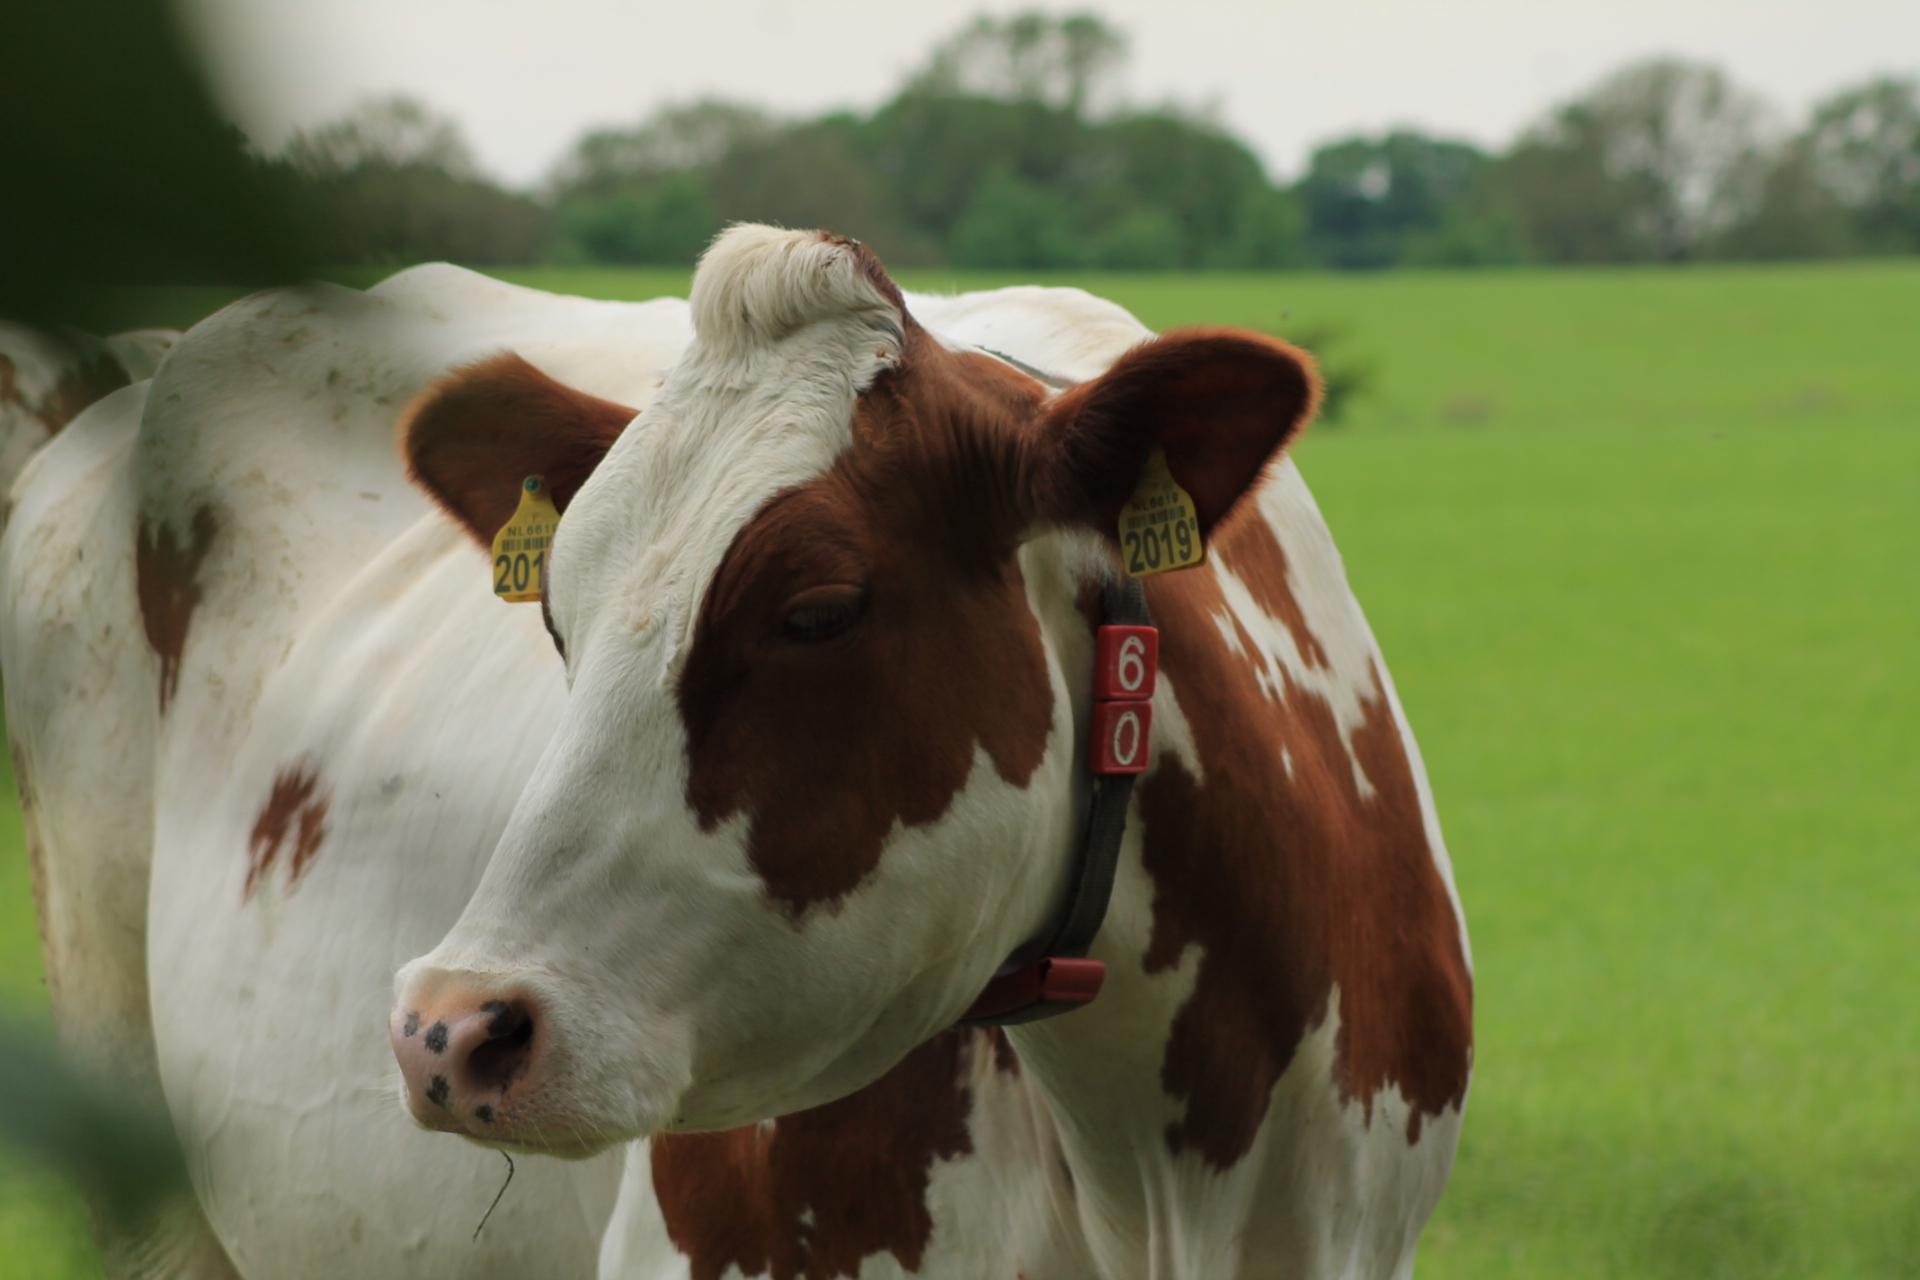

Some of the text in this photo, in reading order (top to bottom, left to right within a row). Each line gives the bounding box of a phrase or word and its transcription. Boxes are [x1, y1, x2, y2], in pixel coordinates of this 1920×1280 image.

[1125, 519, 1193, 573] 2019
[1114, 635, 1146, 766] 6 0
